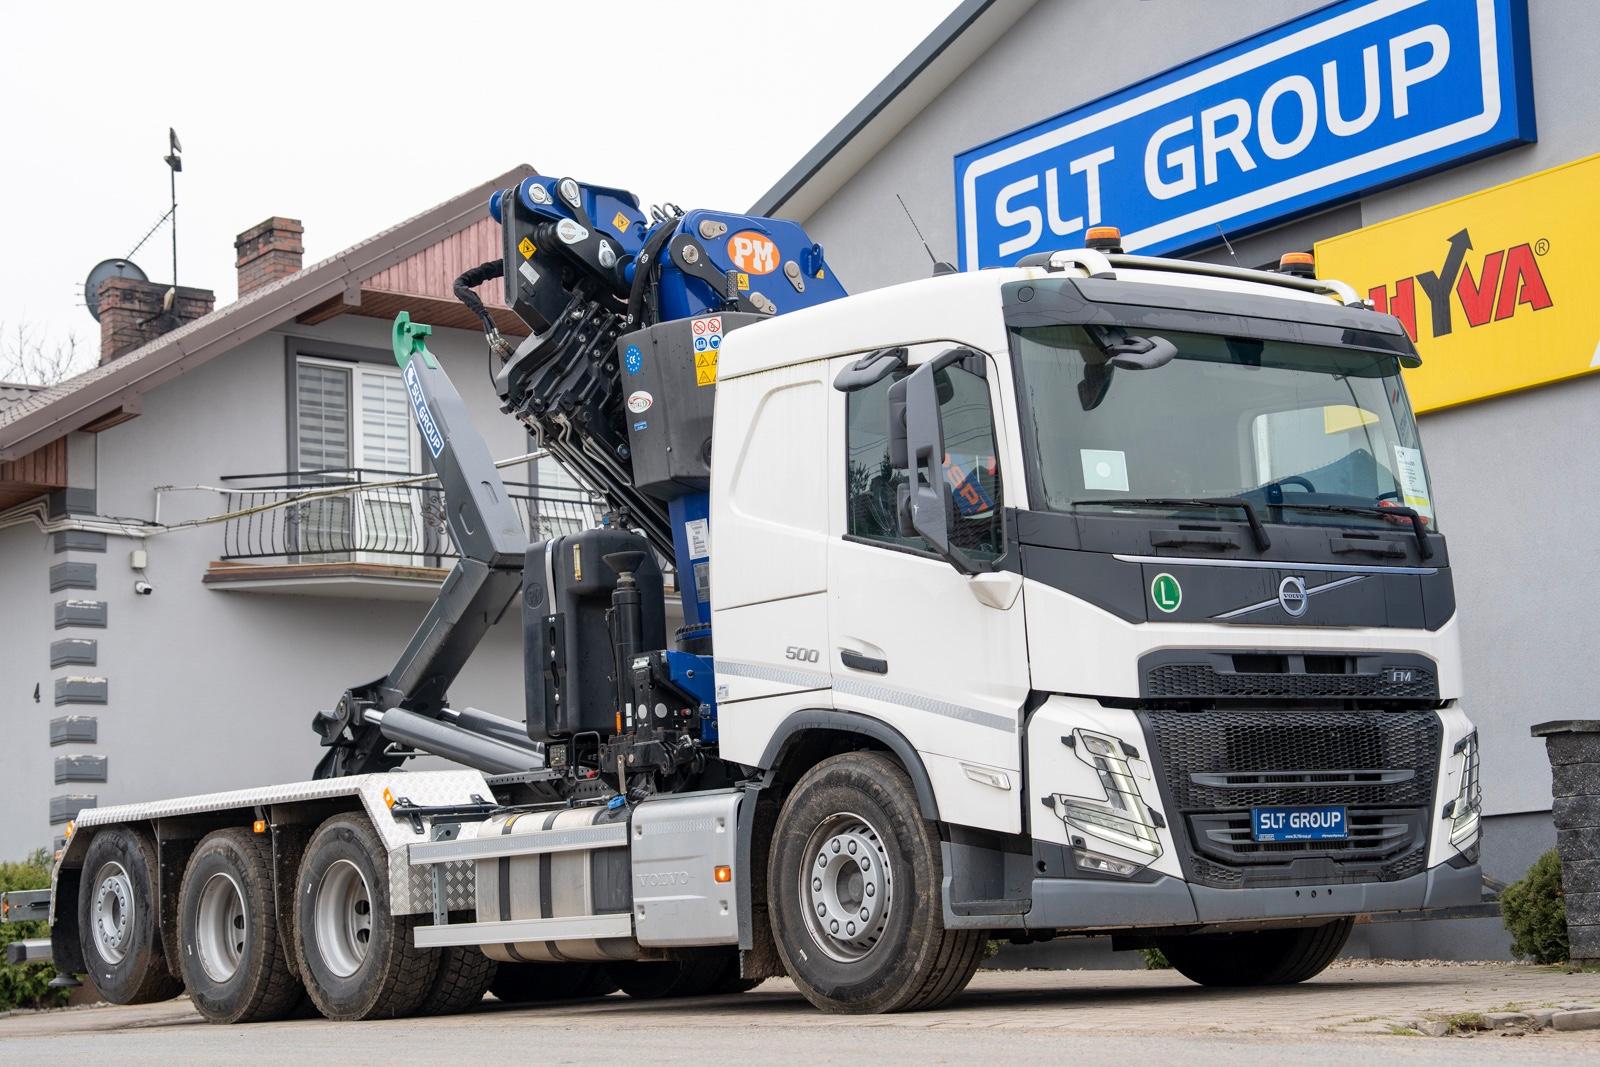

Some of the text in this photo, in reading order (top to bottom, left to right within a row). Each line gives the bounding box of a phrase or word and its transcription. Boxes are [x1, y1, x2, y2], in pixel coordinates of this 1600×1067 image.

[995, 24, 1450, 258] SLT GROUP
[734, 236, 774, 272] PM
[412, 383, 441, 449] SLT GROUP
[1161, 581, 1174, 605] L
[785, 646, 820, 663] 500
[1393, 671, 1411, 682] FM
[1260, 812, 1341, 829] SLT GROUP
[636, 871, 689, 887] VOLVO
